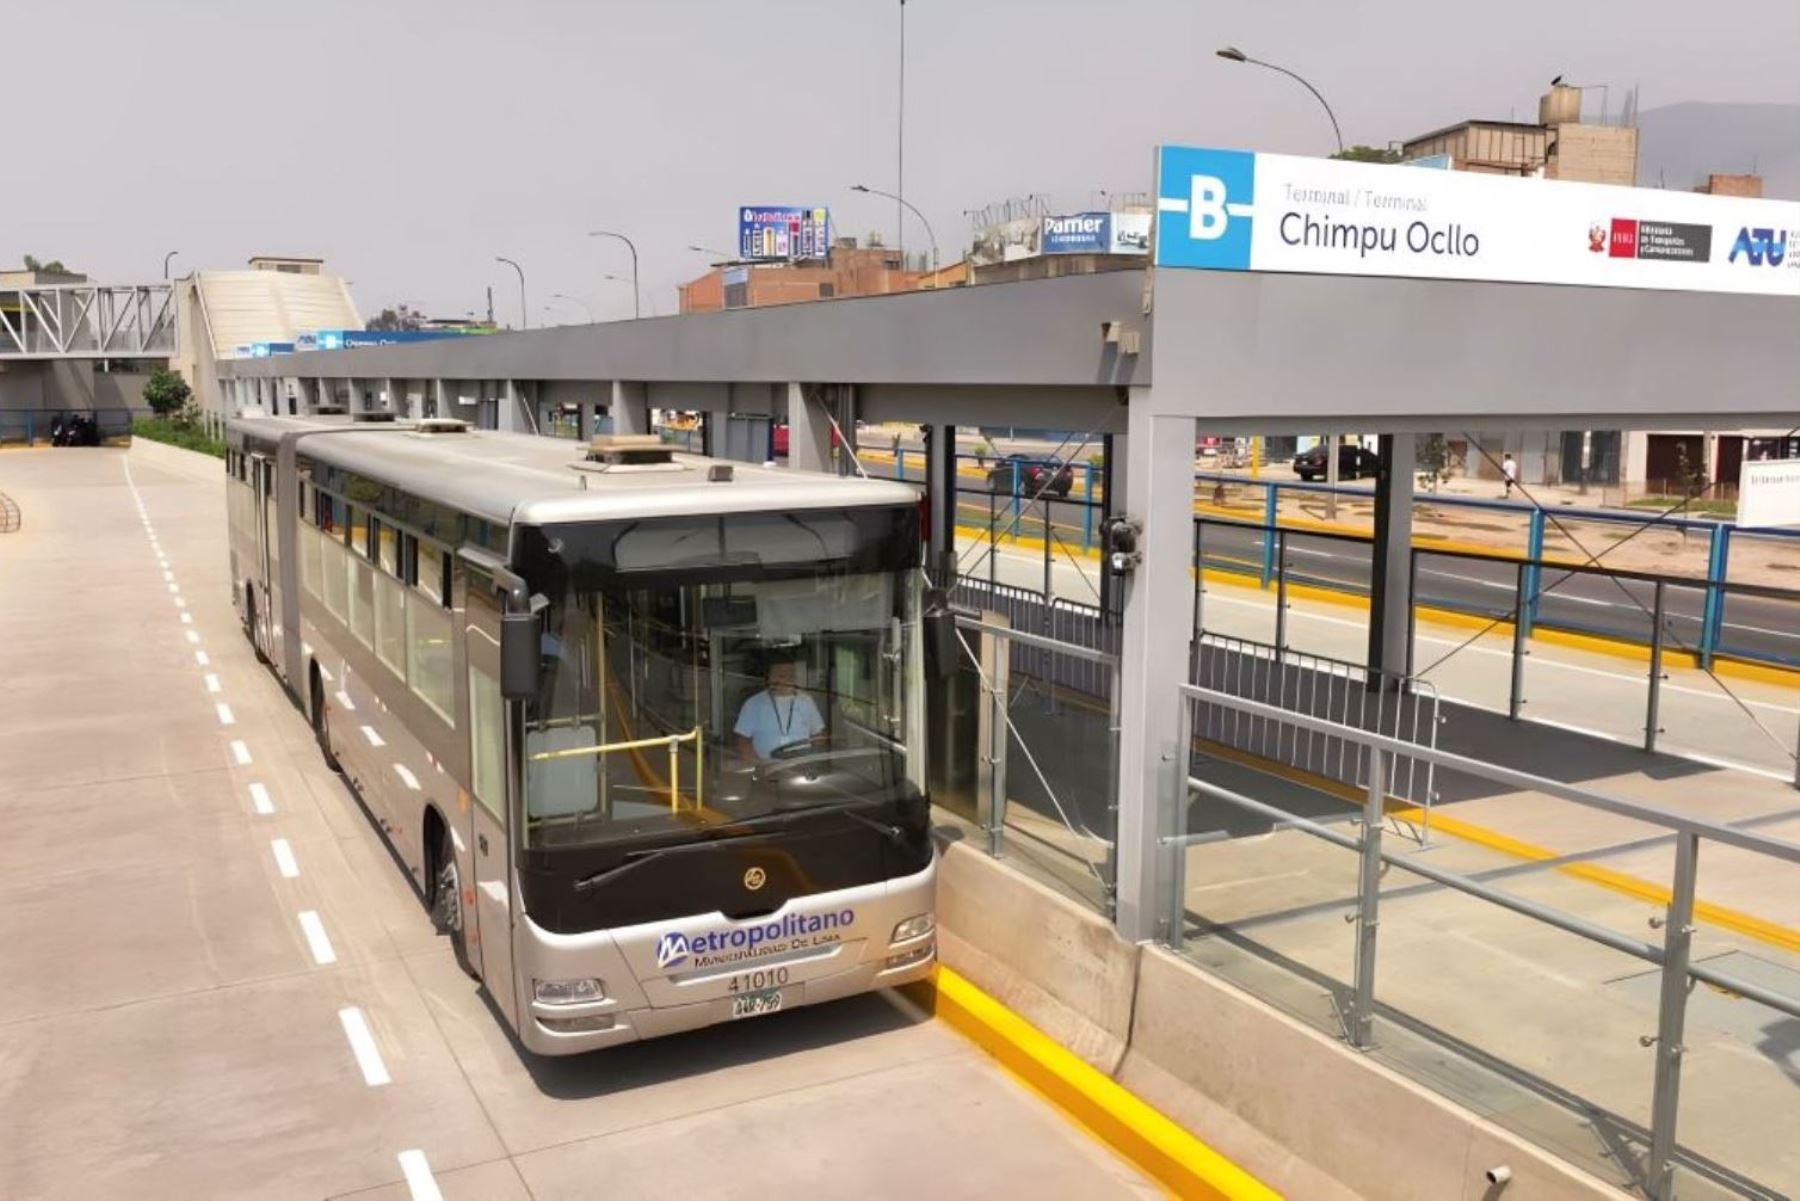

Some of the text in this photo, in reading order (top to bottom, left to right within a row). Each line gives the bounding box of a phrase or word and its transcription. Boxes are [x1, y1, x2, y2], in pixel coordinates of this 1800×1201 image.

[1189, 174, 1228, 240] B
[1284, 183, 1350, 206] Terminal
[1280, 211, 1480, 258] Chimpu Ocllo
[1728, 226, 1787, 267] ATU
[656, 908, 855, 968] Metropolitano
[727, 966, 789, 993] 41010
